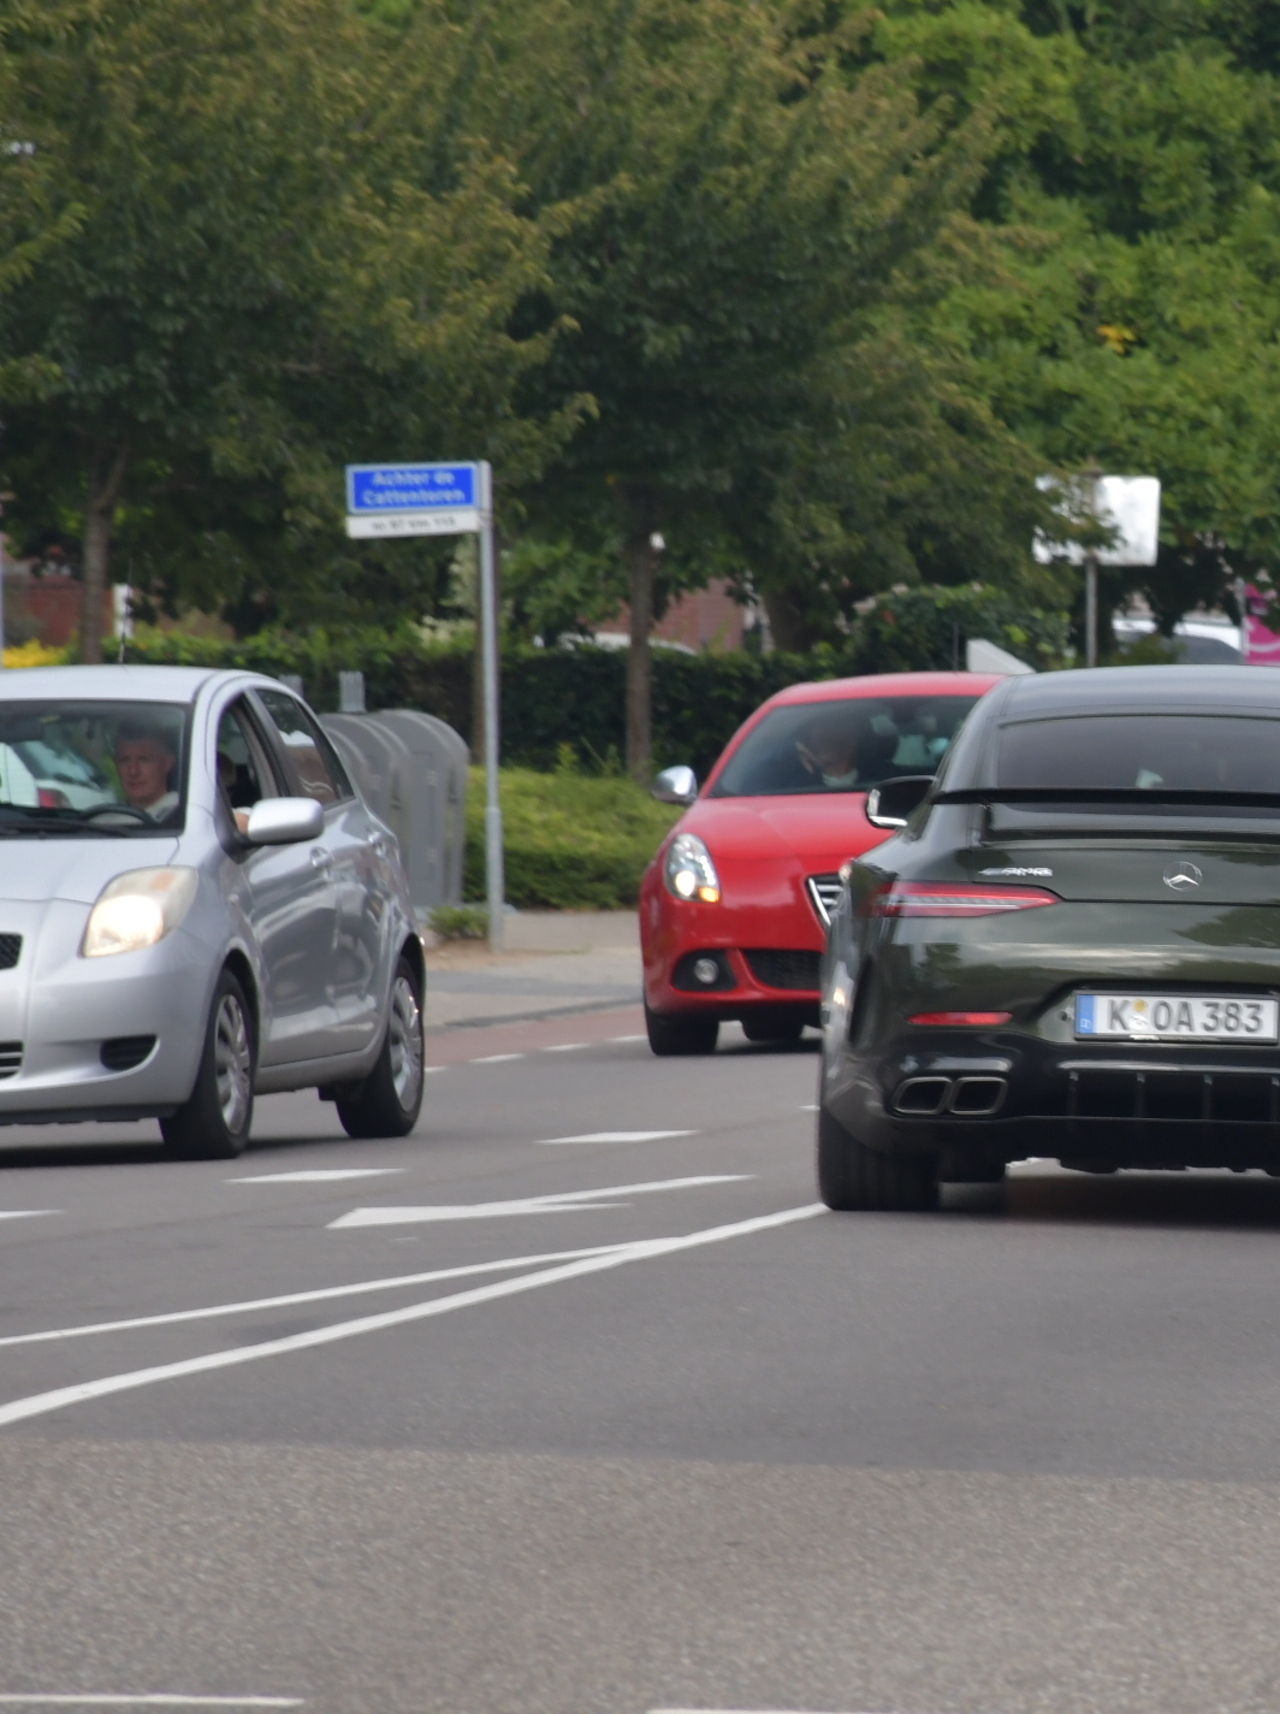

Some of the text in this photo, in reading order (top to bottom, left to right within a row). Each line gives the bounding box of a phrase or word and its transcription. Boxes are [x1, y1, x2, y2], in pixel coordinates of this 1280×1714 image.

[372, 470, 456, 487] Achter de
[1107, 999, 1263, 1032] K OA 383
